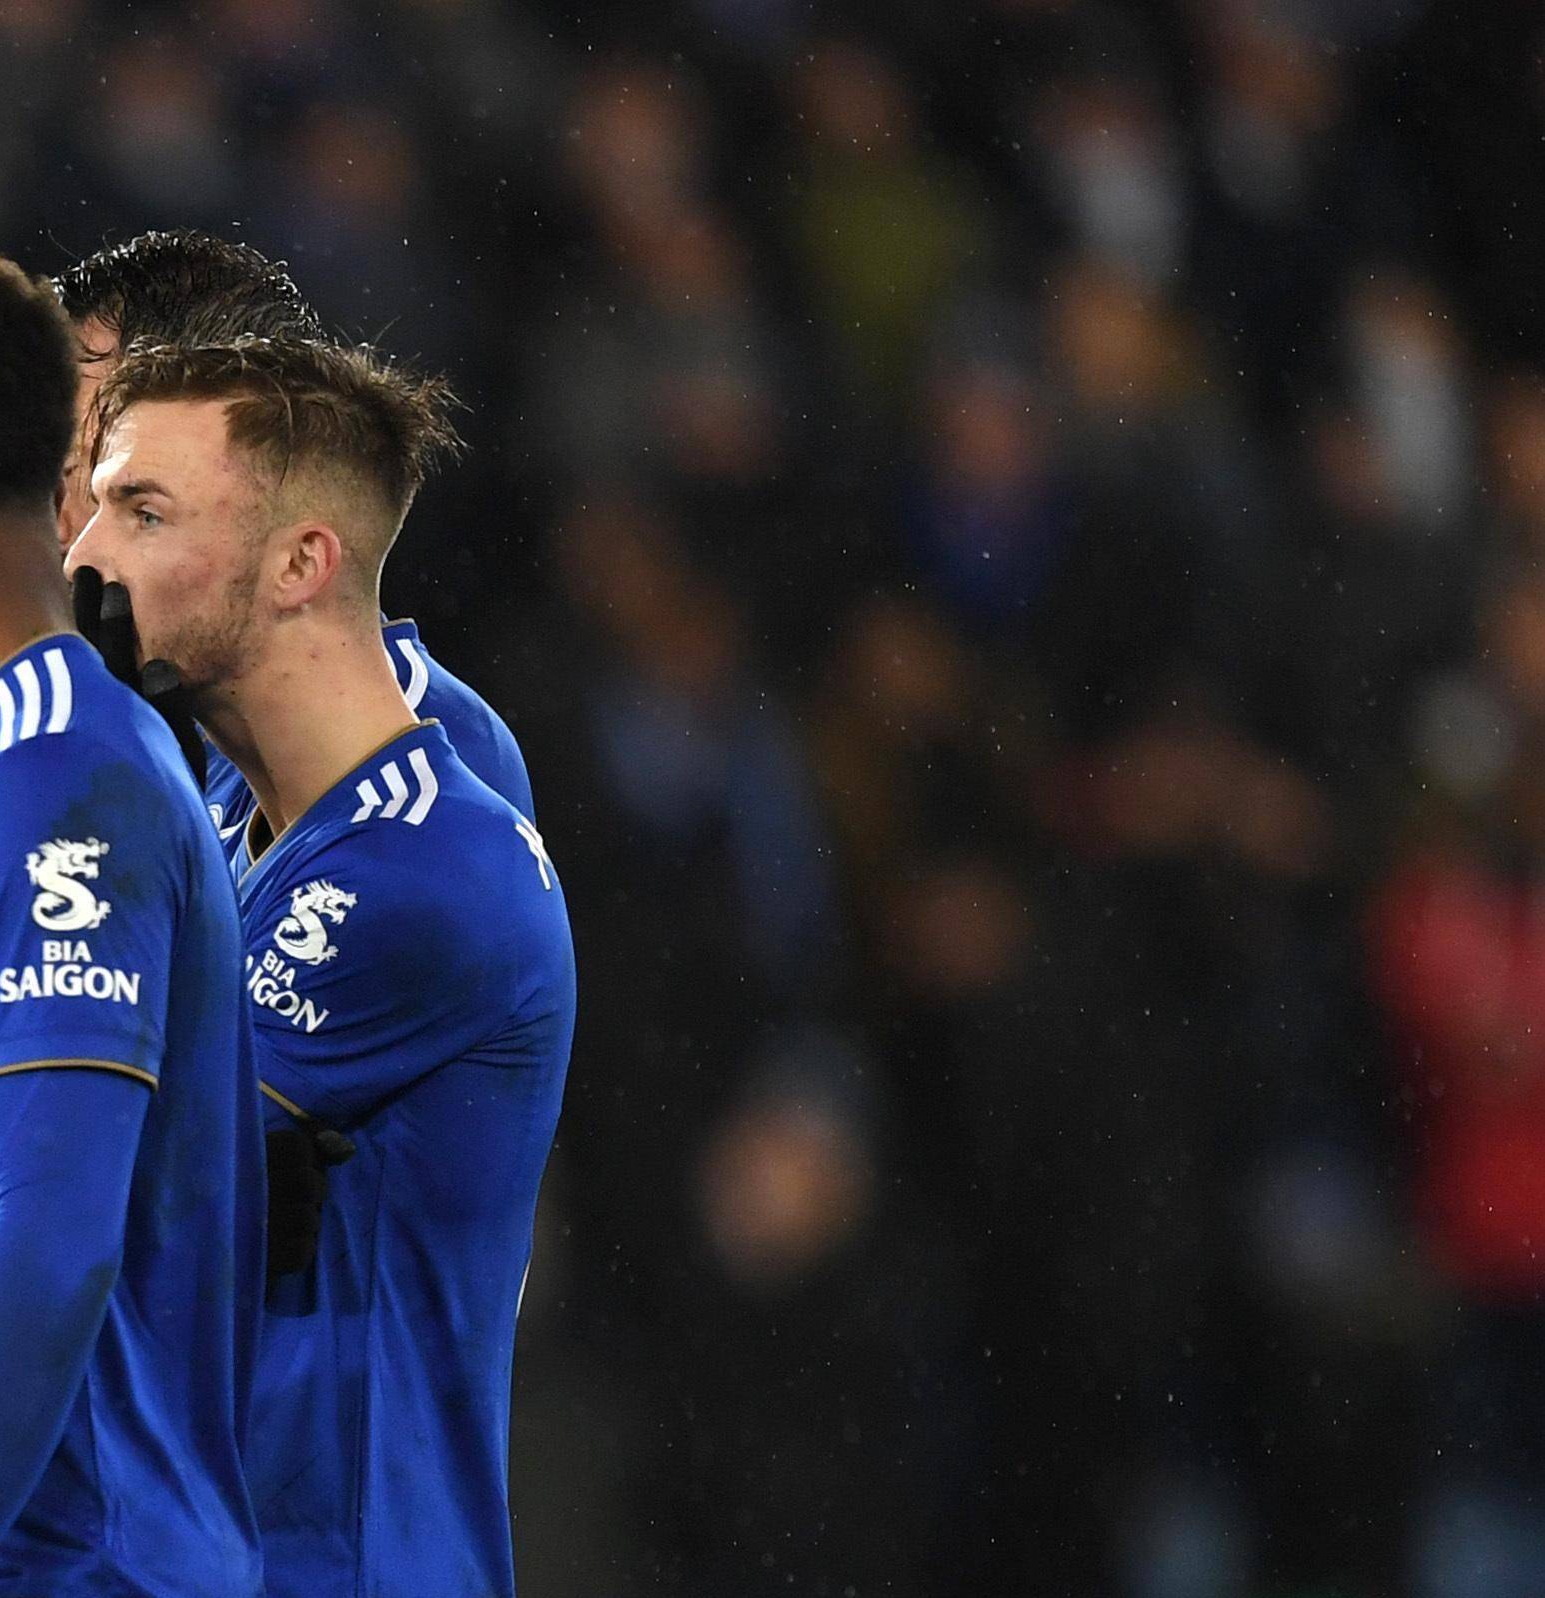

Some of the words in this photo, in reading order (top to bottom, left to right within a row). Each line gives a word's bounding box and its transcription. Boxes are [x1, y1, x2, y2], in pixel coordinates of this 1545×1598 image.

[42, 939, 93, 963] BIA
[262, 949, 297, 989] BIA
[245, 954, 330, 1034] IGON
